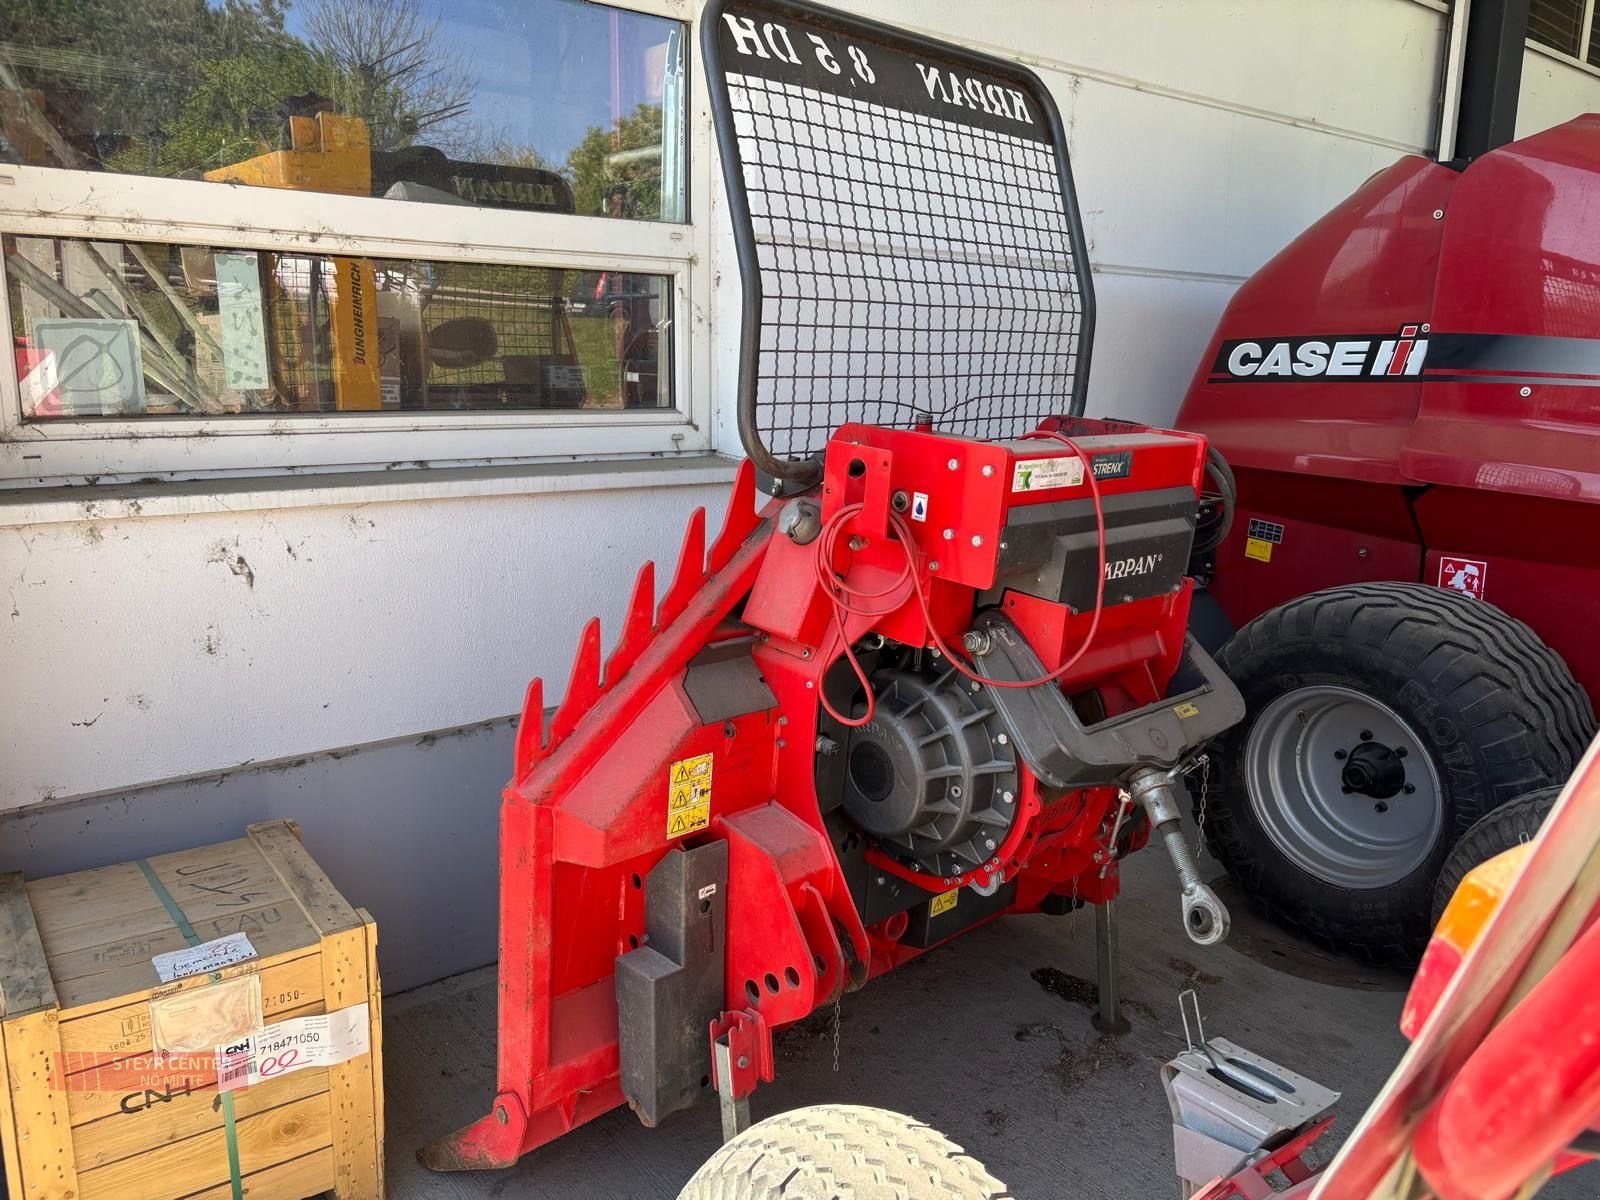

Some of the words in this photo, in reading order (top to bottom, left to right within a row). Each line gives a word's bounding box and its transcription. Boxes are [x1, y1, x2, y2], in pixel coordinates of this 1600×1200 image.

[351, 262, 366, 366] JUNGHEINRICH
[1227, 340, 1372, 377] CASE
[1093, 461, 1123, 476] STRENX
[259, 1031, 321, 1056] 718471050
[120, 1077, 191, 1114] CNH
